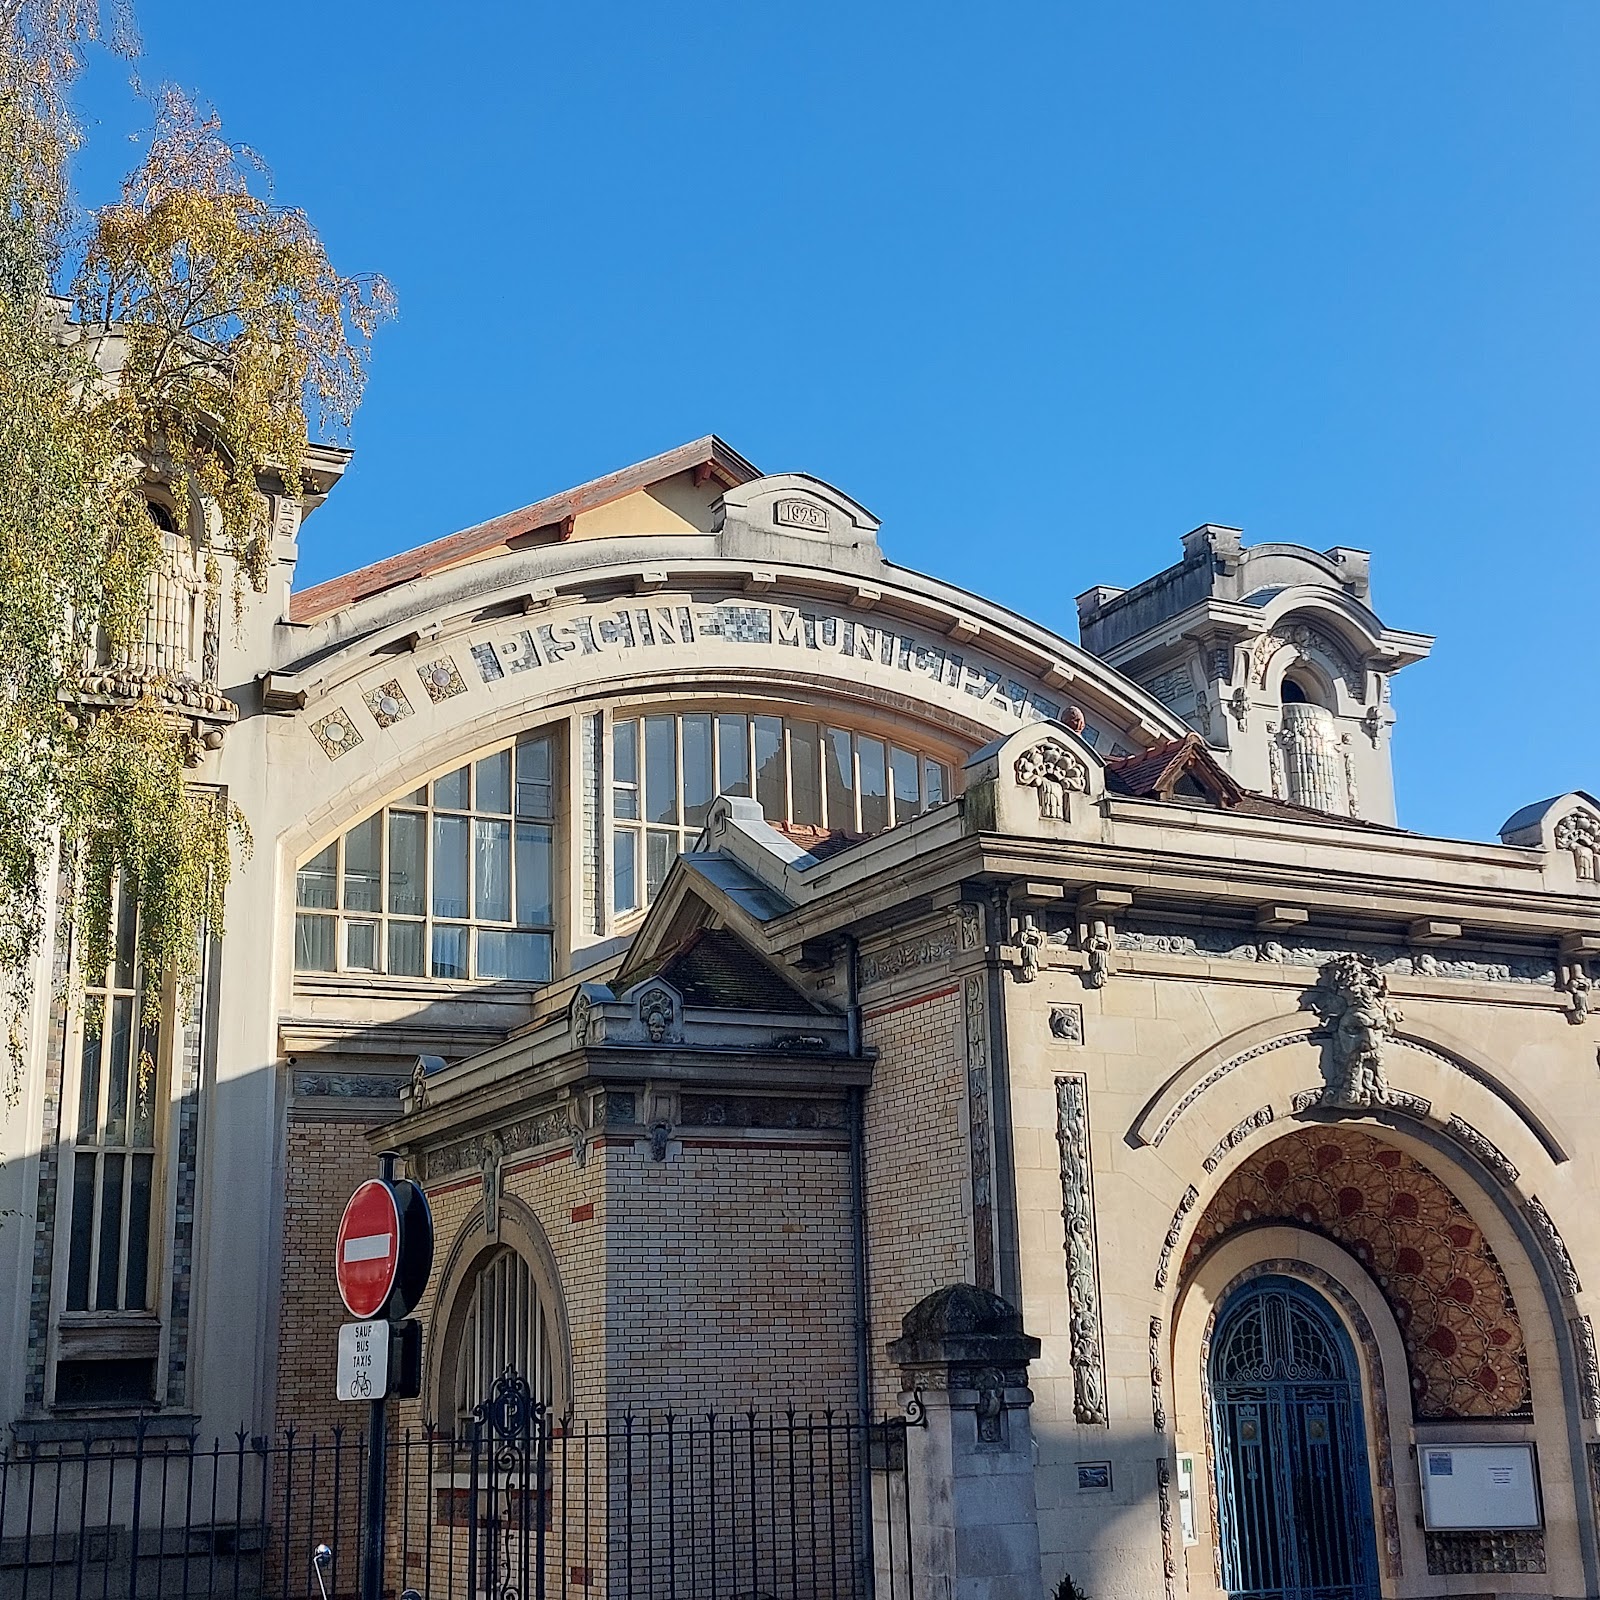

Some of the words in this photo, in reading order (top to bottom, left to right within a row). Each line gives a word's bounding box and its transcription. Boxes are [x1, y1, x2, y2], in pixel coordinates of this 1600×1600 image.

[786, 504, 818, 525] 1925
[489, 605, 723, 678] PISCINE
[771, 608, 1047, 725] MUNICIPAL
[355, 1325, 373, 1338] SAUF
[356, 1340, 370, 1353] BUS
[353, 1355, 372, 1368] TAXIS
